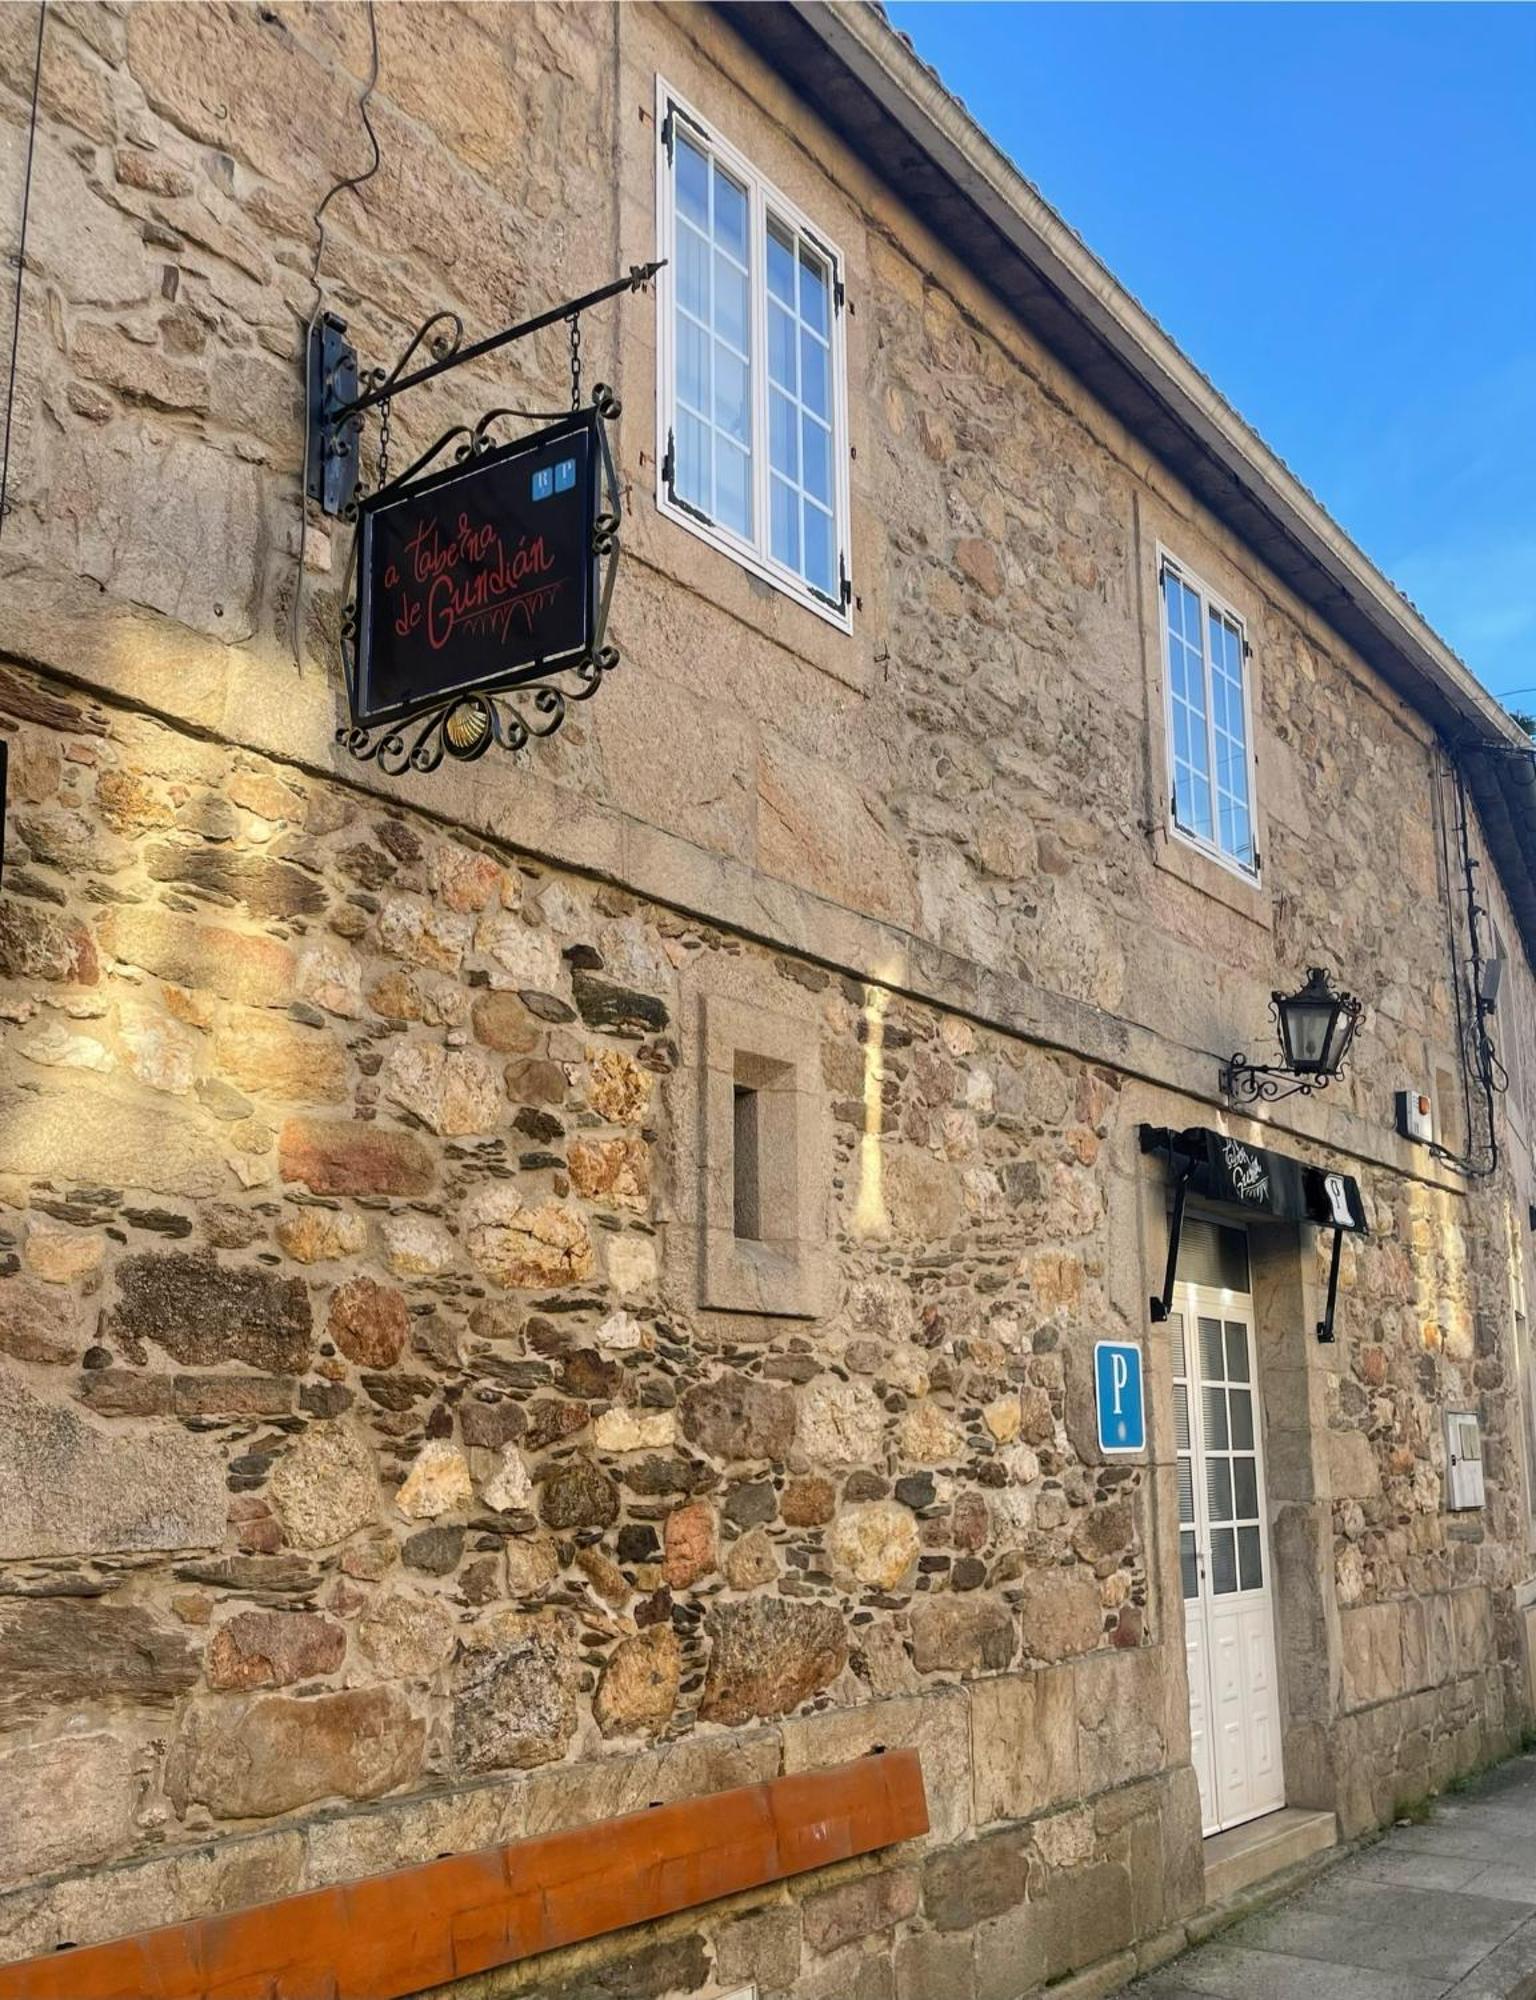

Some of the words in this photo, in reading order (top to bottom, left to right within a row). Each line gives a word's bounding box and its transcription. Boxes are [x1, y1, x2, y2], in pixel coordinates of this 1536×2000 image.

[384, 565, 400, 589] a
[395, 591, 422, 636] de
[428, 535, 556, 649] Gundián
[1111, 1353, 1128, 1415] P
